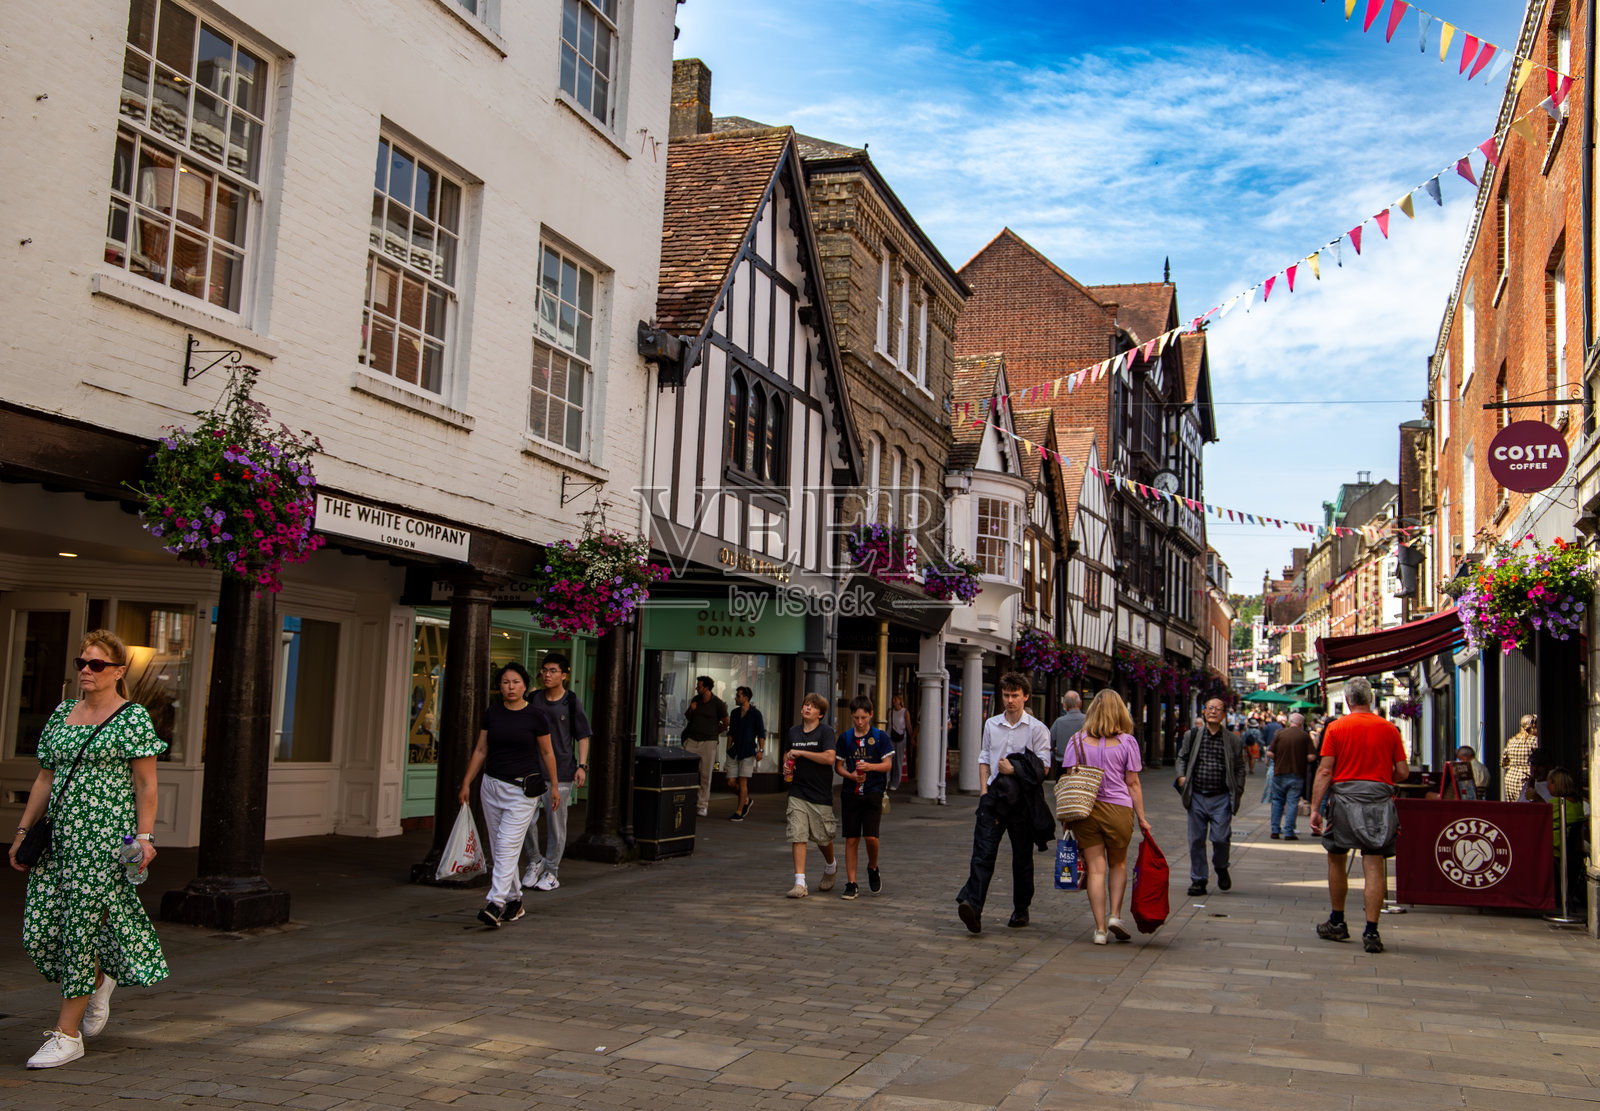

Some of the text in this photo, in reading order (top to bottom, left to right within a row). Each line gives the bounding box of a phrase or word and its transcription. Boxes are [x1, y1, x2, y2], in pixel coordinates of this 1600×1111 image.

[1494, 444, 1562, 461] COSTA
[1509, 462, 1548, 470] COFFEE
[324, 497, 466, 546] THE WHITE COMPANY
[381, 534, 416, 549] LONDON
[720, 547, 790, 583] OLIVER BONAS
[697, 625, 756, 637] BONAS
[1445, 820, 1499, 842] COSTA
[1059, 851, 1076, 860] M&S
[1441, 859, 1507, 887] COFFEE
